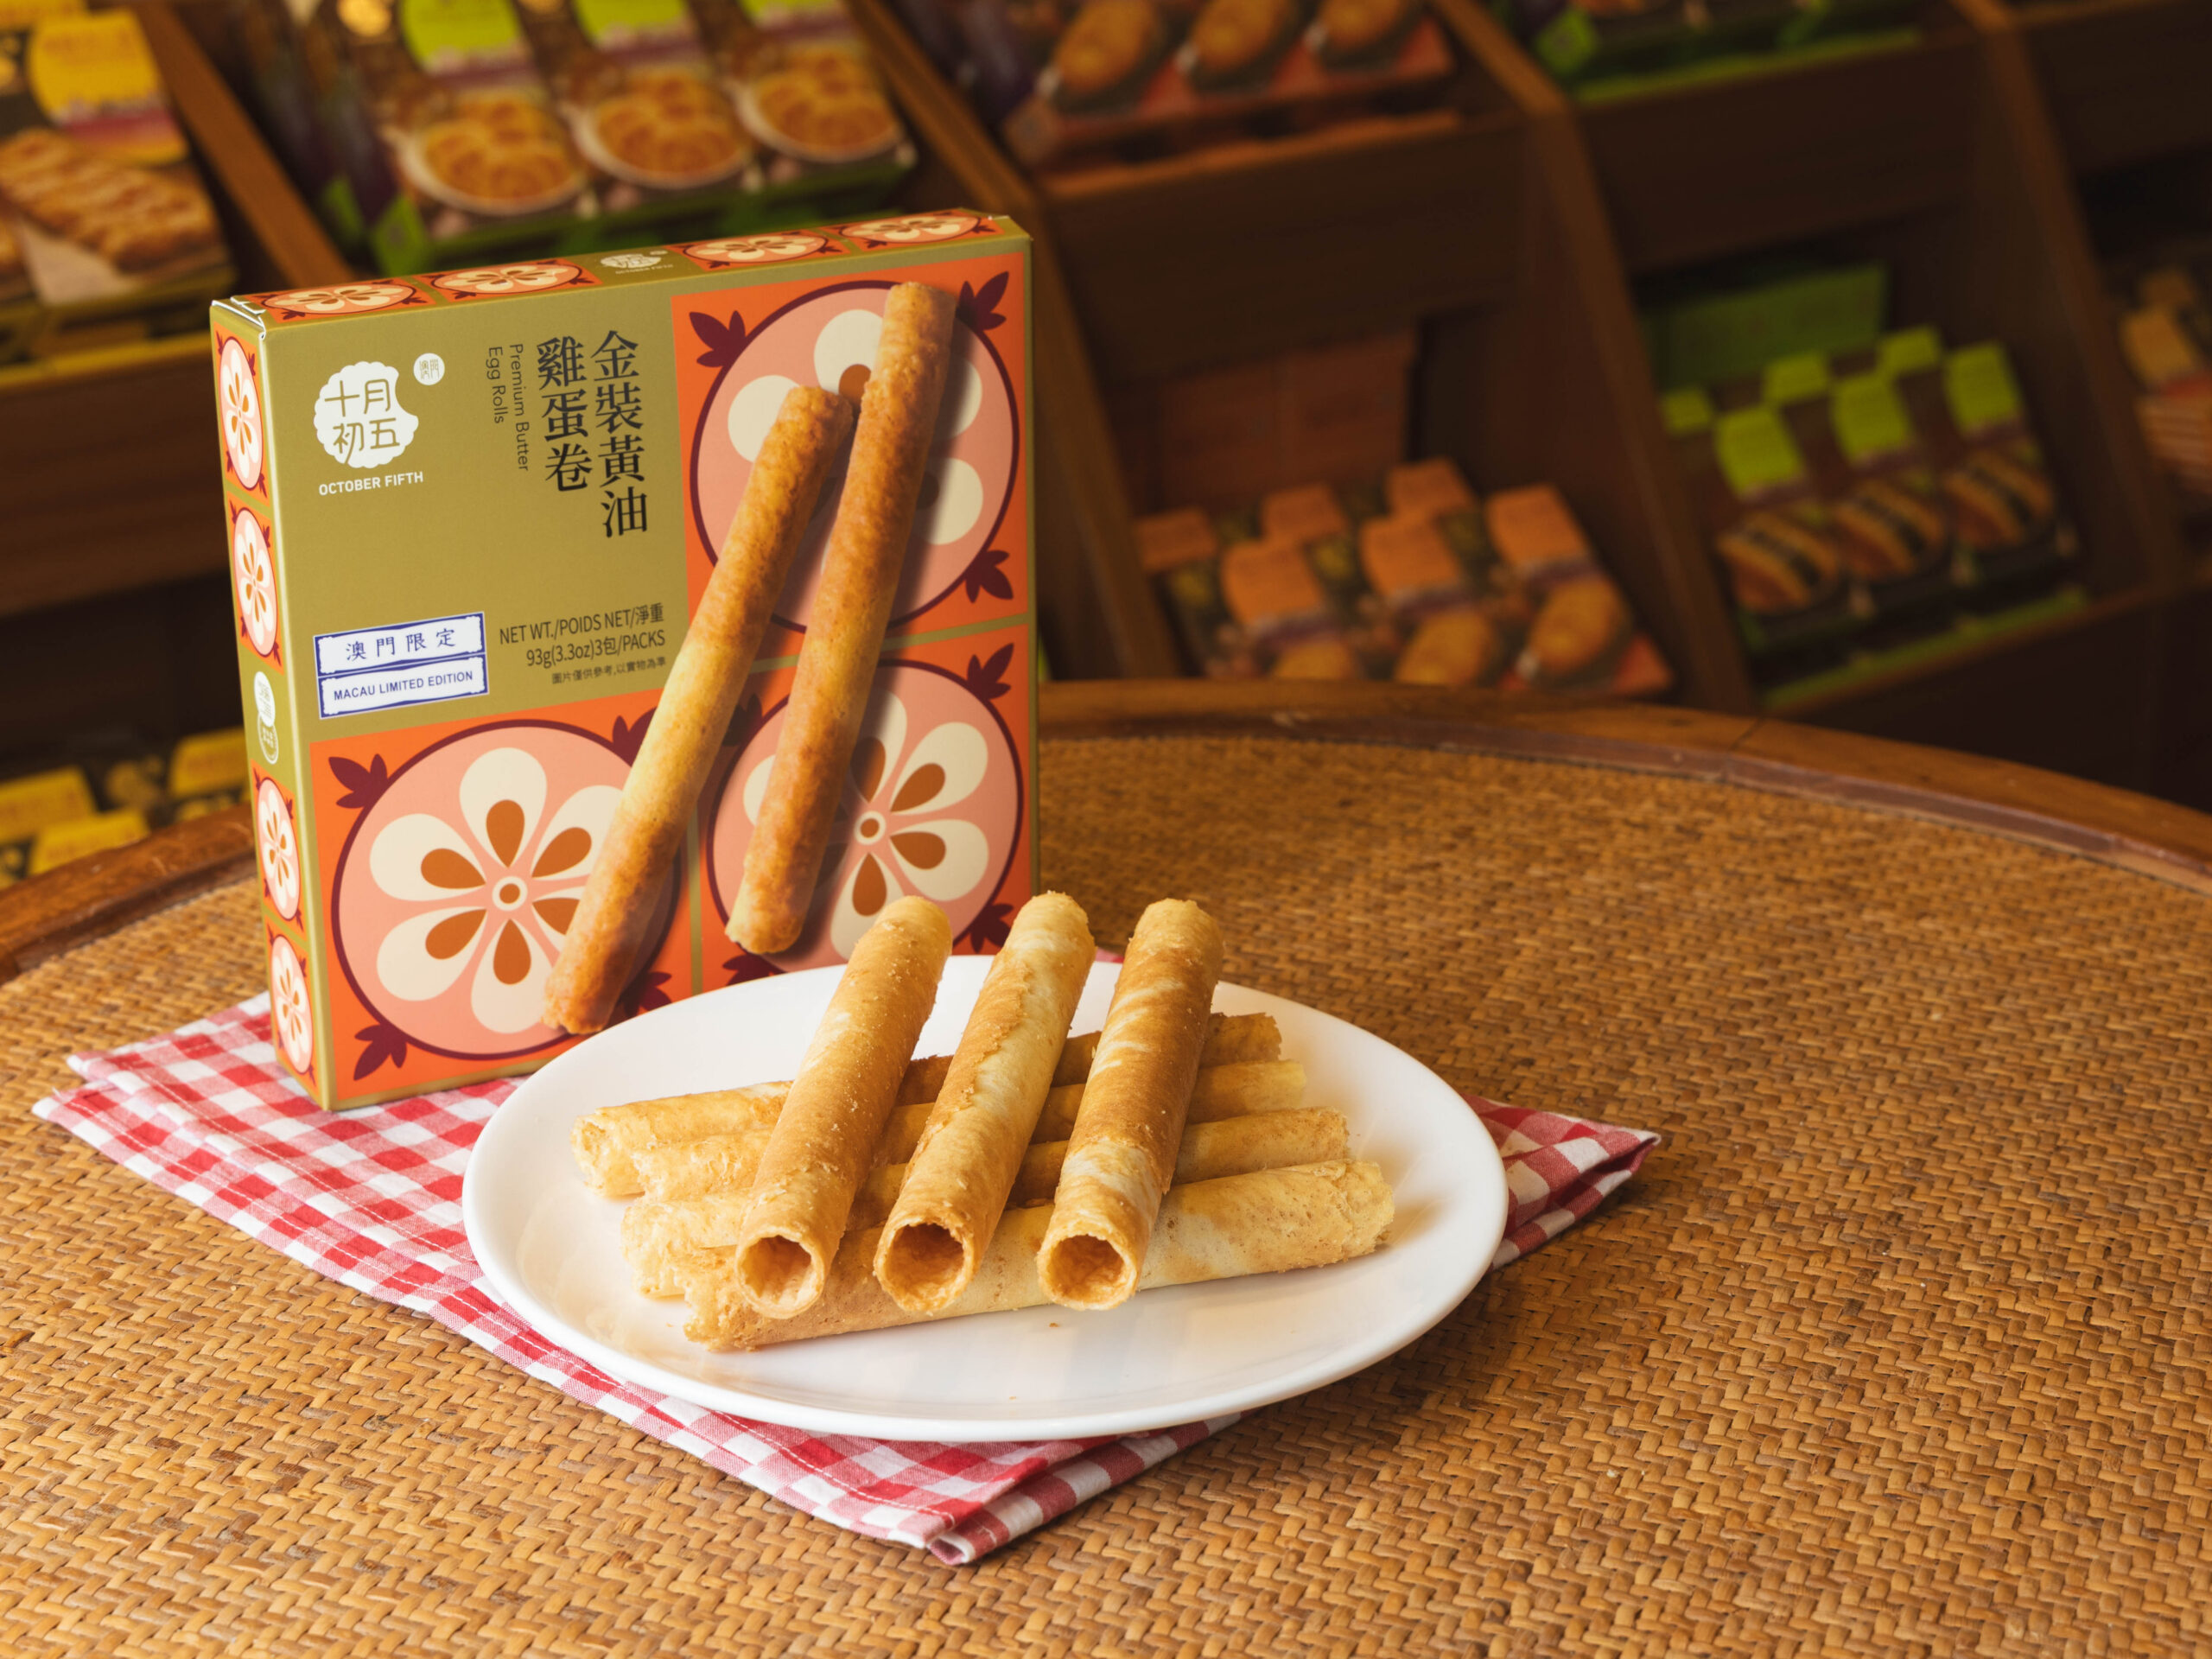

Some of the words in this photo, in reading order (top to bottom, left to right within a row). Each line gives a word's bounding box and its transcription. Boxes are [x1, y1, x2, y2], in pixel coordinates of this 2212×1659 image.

[486, 346, 504, 380] Egg
[509, 343, 526, 416] Premium
[493, 385, 508, 424] Rolls
[537, 335, 594, 492] 雞蛋卷
[516, 422, 530, 472] Butter
[590, 330, 647, 538] 金裝黃油
[319, 476, 381, 496] OCTOBER
[385, 471, 424, 487] FIFTH
[346, 628, 456, 662] 澳門限定
[499, 624, 527, 645] NET
[530, 613, 602, 640] WT./POIDS
[334, 685, 376, 702] MACAU
[379, 677, 424, 695] LIMITED
[428, 671, 474, 687] EDITION
